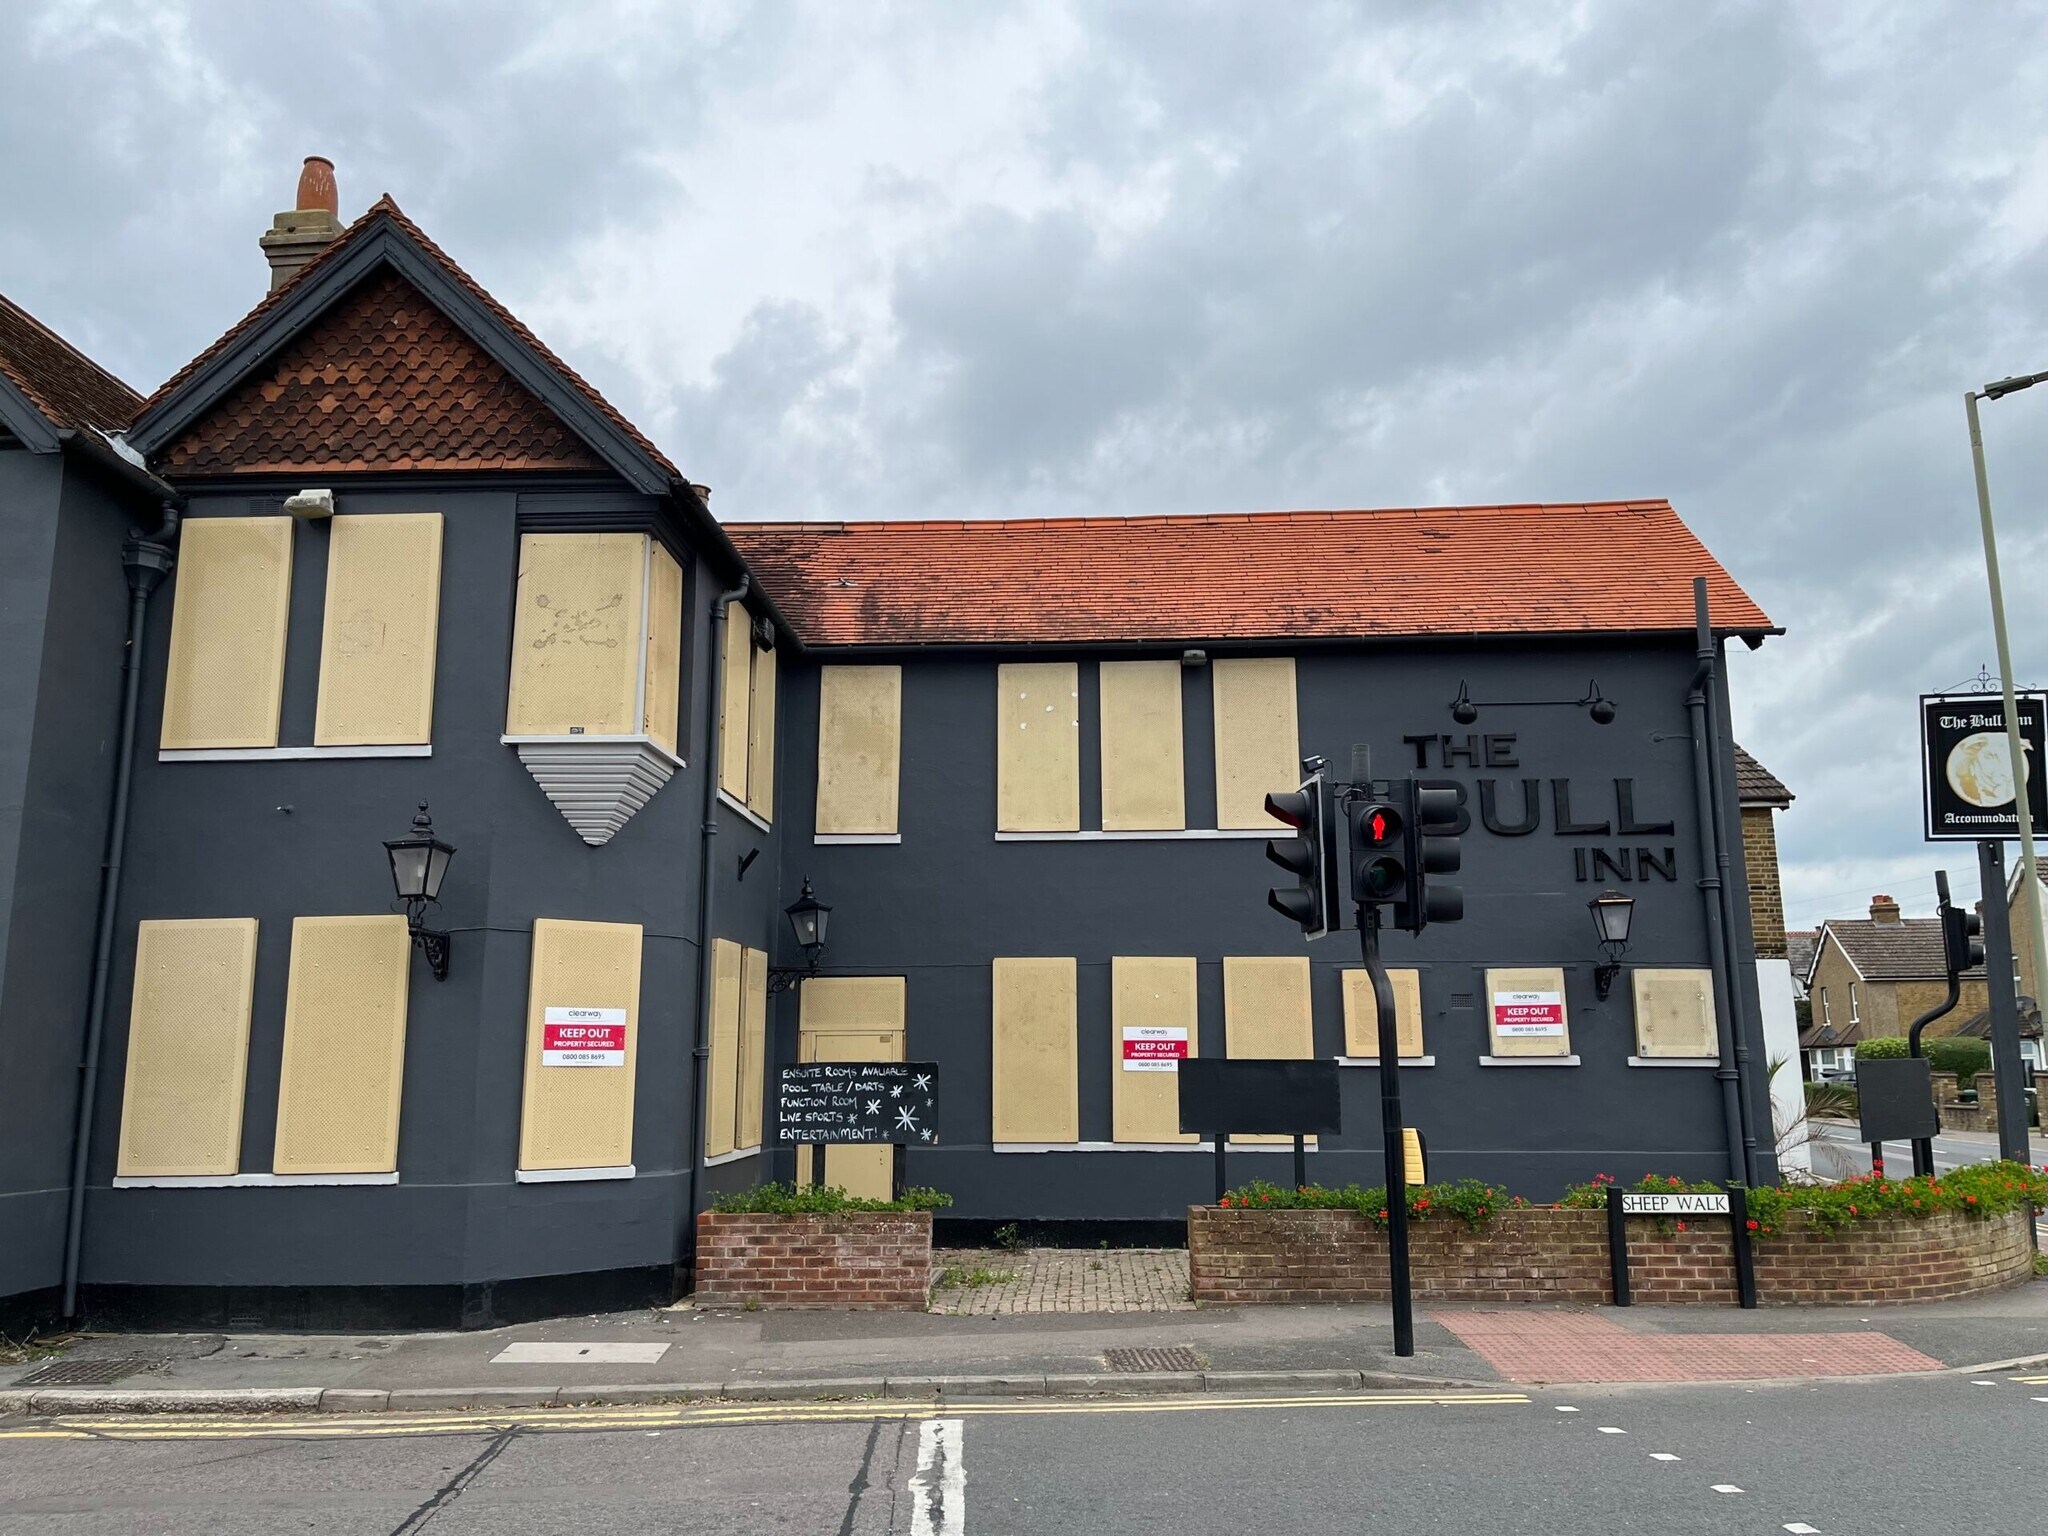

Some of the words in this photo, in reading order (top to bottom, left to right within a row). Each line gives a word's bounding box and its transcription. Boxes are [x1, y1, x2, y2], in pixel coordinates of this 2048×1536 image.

[1939, 715, 1967, 730] The
[1969, 714, 2002, 729] Bull
[2004, 715, 2033, 727] nn
[1403, 733, 1519, 768] THE
[1573, 847, 1677, 882] INN
[568, 1010, 601, 1019] clearway
[1530, 1007, 1549, 1015] OUT
[560, 1028, 586, 1038] KEEP
[587, 1028, 611, 1038] OUT
[782, 1067, 822, 1079] ENSUITE
[825, 1066, 857, 1079] ROOMS
[782, 1083, 809, 1094] POOL
[811, 1082, 845, 1093] TABLE
[780, 1096, 828, 1108] FUNCTION
[831, 1096, 858, 1110] ROOM
[780, 1111, 801, 1122] LIVE
[805, 1112, 843, 1122] SPORTS
[780, 1126, 878, 1140] ENTERTAINMENT!
[1622, 1196, 1669, 1211] SHEEP
[1676, 1196, 1726, 1211] WALK
